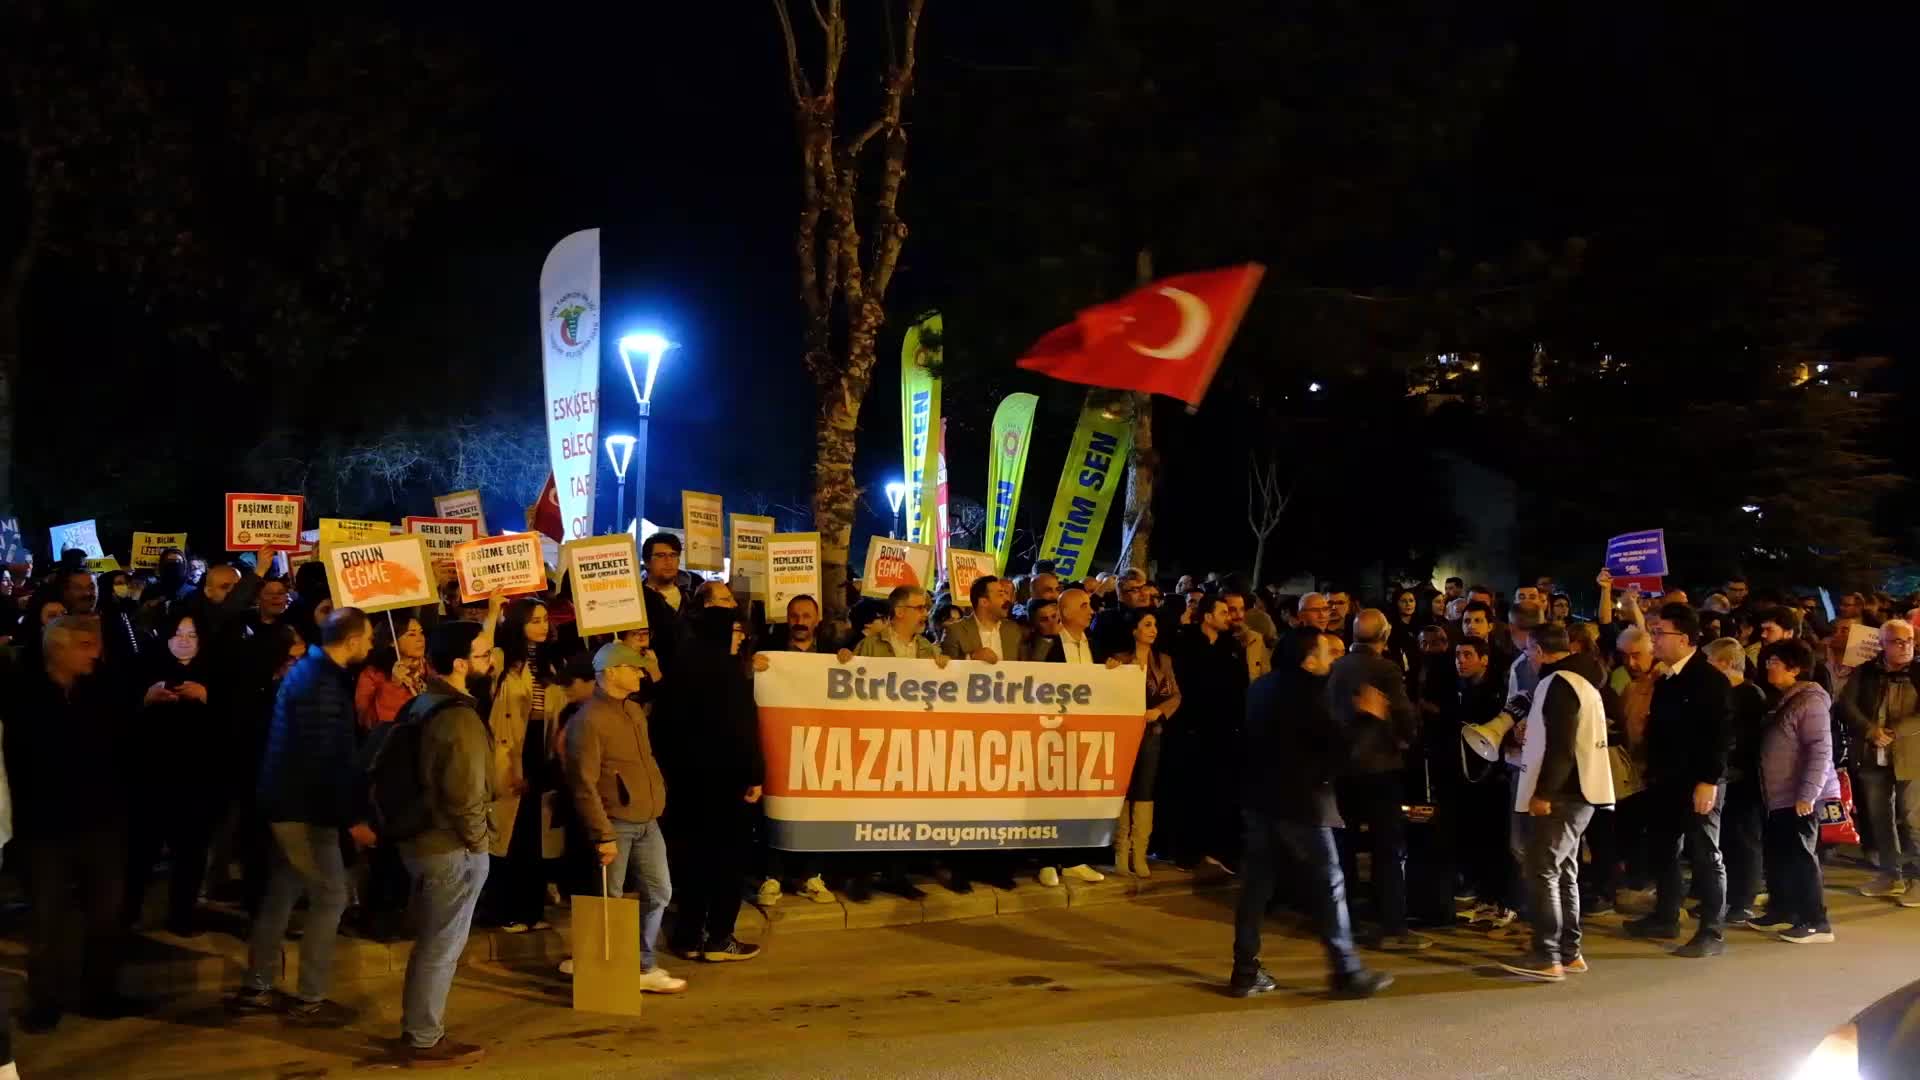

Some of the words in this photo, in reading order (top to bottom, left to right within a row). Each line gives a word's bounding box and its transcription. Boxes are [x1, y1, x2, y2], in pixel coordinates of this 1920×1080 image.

[553, 391, 599, 421] ESKİŞEH
[562, 432, 593, 460] BİLEC
[238, 502, 273, 516] FAŞİZME
[1055, 496, 1097, 583] ĞİTİM
[1079, 431, 1118, 491] SEN
[241, 519, 293, 529] VERMEYELİM!
[421, 524, 442, 534] GENEL
[444, 525, 463, 535] GREV
[737, 535, 763, 544] MEMLEKE
[341, 546, 384, 568] BOYUN
[465, 547, 504, 562] FAŞİZME
[506, 541, 530, 556] GEÇİT
[773, 556, 813, 565] MEMLEKETE
[880, 545, 906, 561] BOYUN
[579, 558, 629, 572] MEMLEKETE
[955, 556, 977, 569] BOYUN
[827, 666, 959, 711] Birleşe
[966, 671, 1092, 713] Birleşe
[788, 715, 1115, 792] KAZANACAĞIZ!
[855, 823, 911, 841] Halk
[915, 824, 1058, 846] Dayanışması
